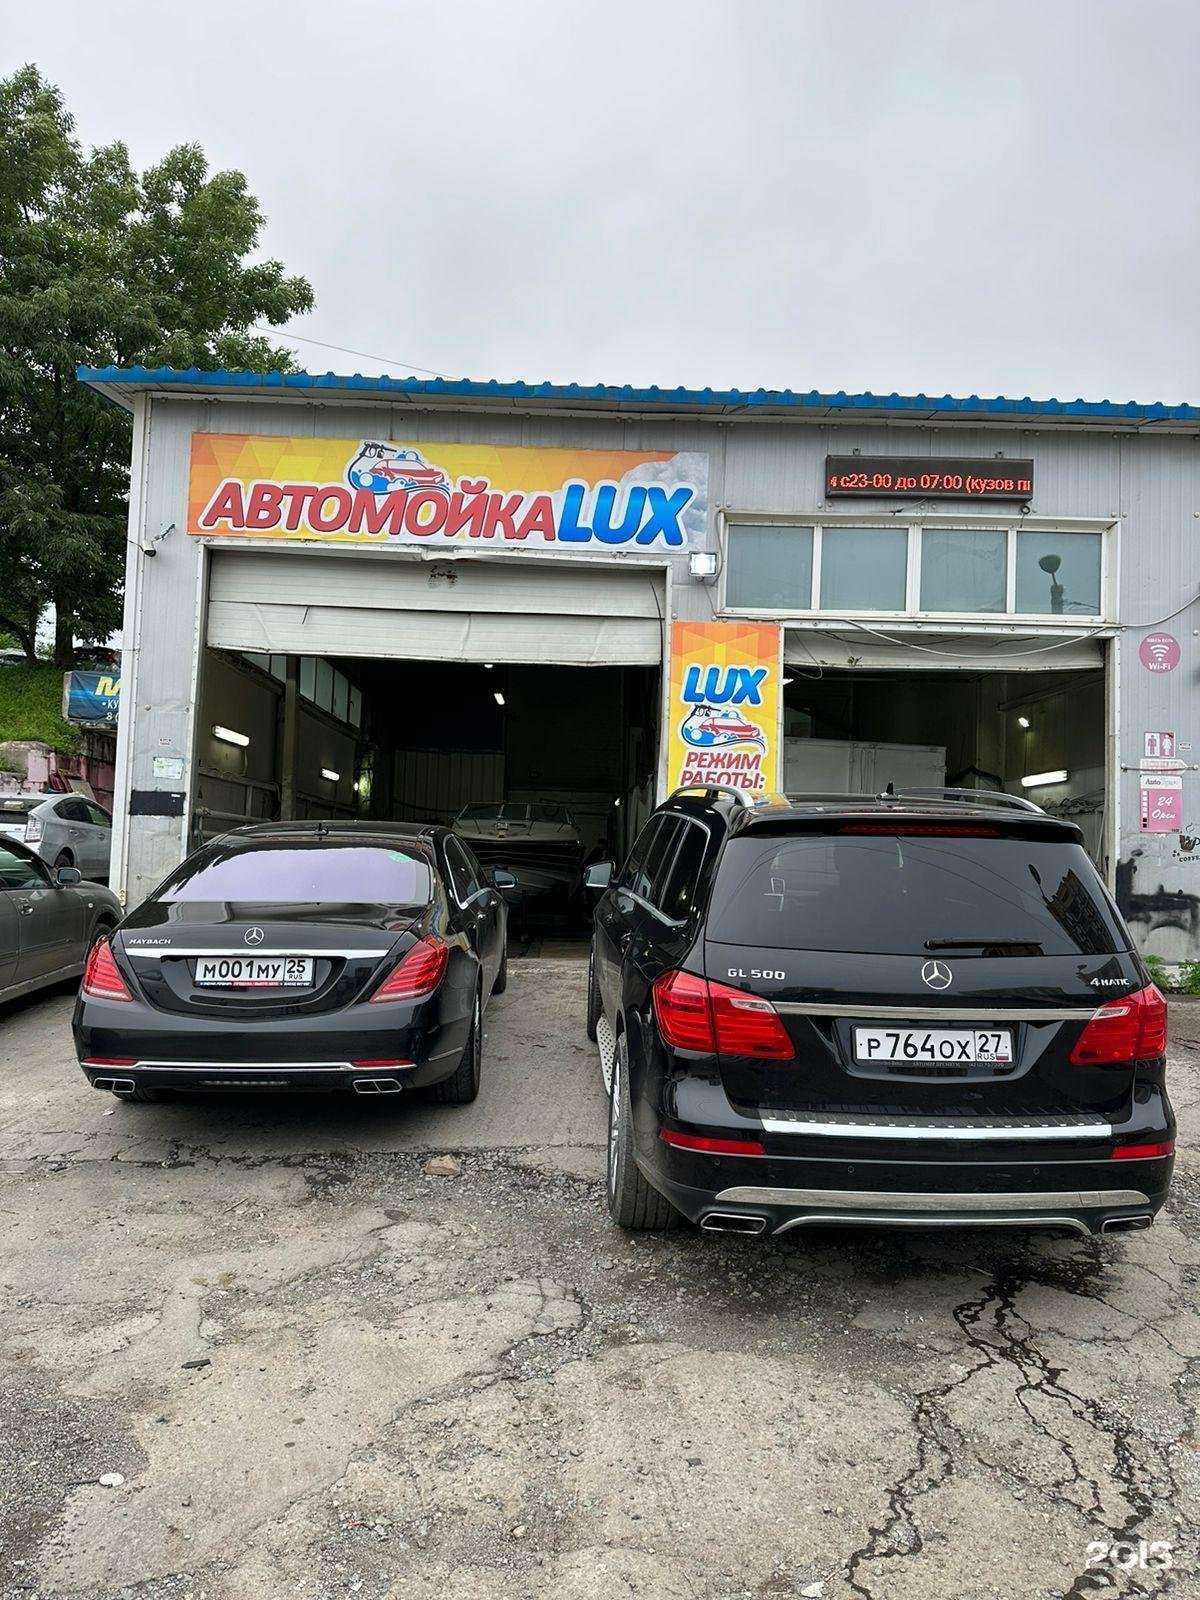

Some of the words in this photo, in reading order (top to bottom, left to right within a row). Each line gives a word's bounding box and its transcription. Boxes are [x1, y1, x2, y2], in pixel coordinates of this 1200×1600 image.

[894, 476, 917, 490] до
[920, 474, 963, 490] 07:00
[1148, 662, 1171, 670] Wi-Fi
[683, 666, 767, 705] LUX
[685, 751, 761, 770] РЕЖИМ
[680, 770, 765, 790] РАБОТЫ:
[1157, 795, 1174, 806] 24
[1151, 808, 1177, 819] Open
[203, 960, 281, 979] М001МУ
[286, 959, 306, 974] 25
[727, 968, 747, 978] GL
[750, 969, 786, 980] 500
[288, 973, 304, 981] RUS
[867, 1033, 971, 1060] Р764ОХ
[977, 1033, 1002, 1053] 27
[977, 1052, 995, 1061] RUS
